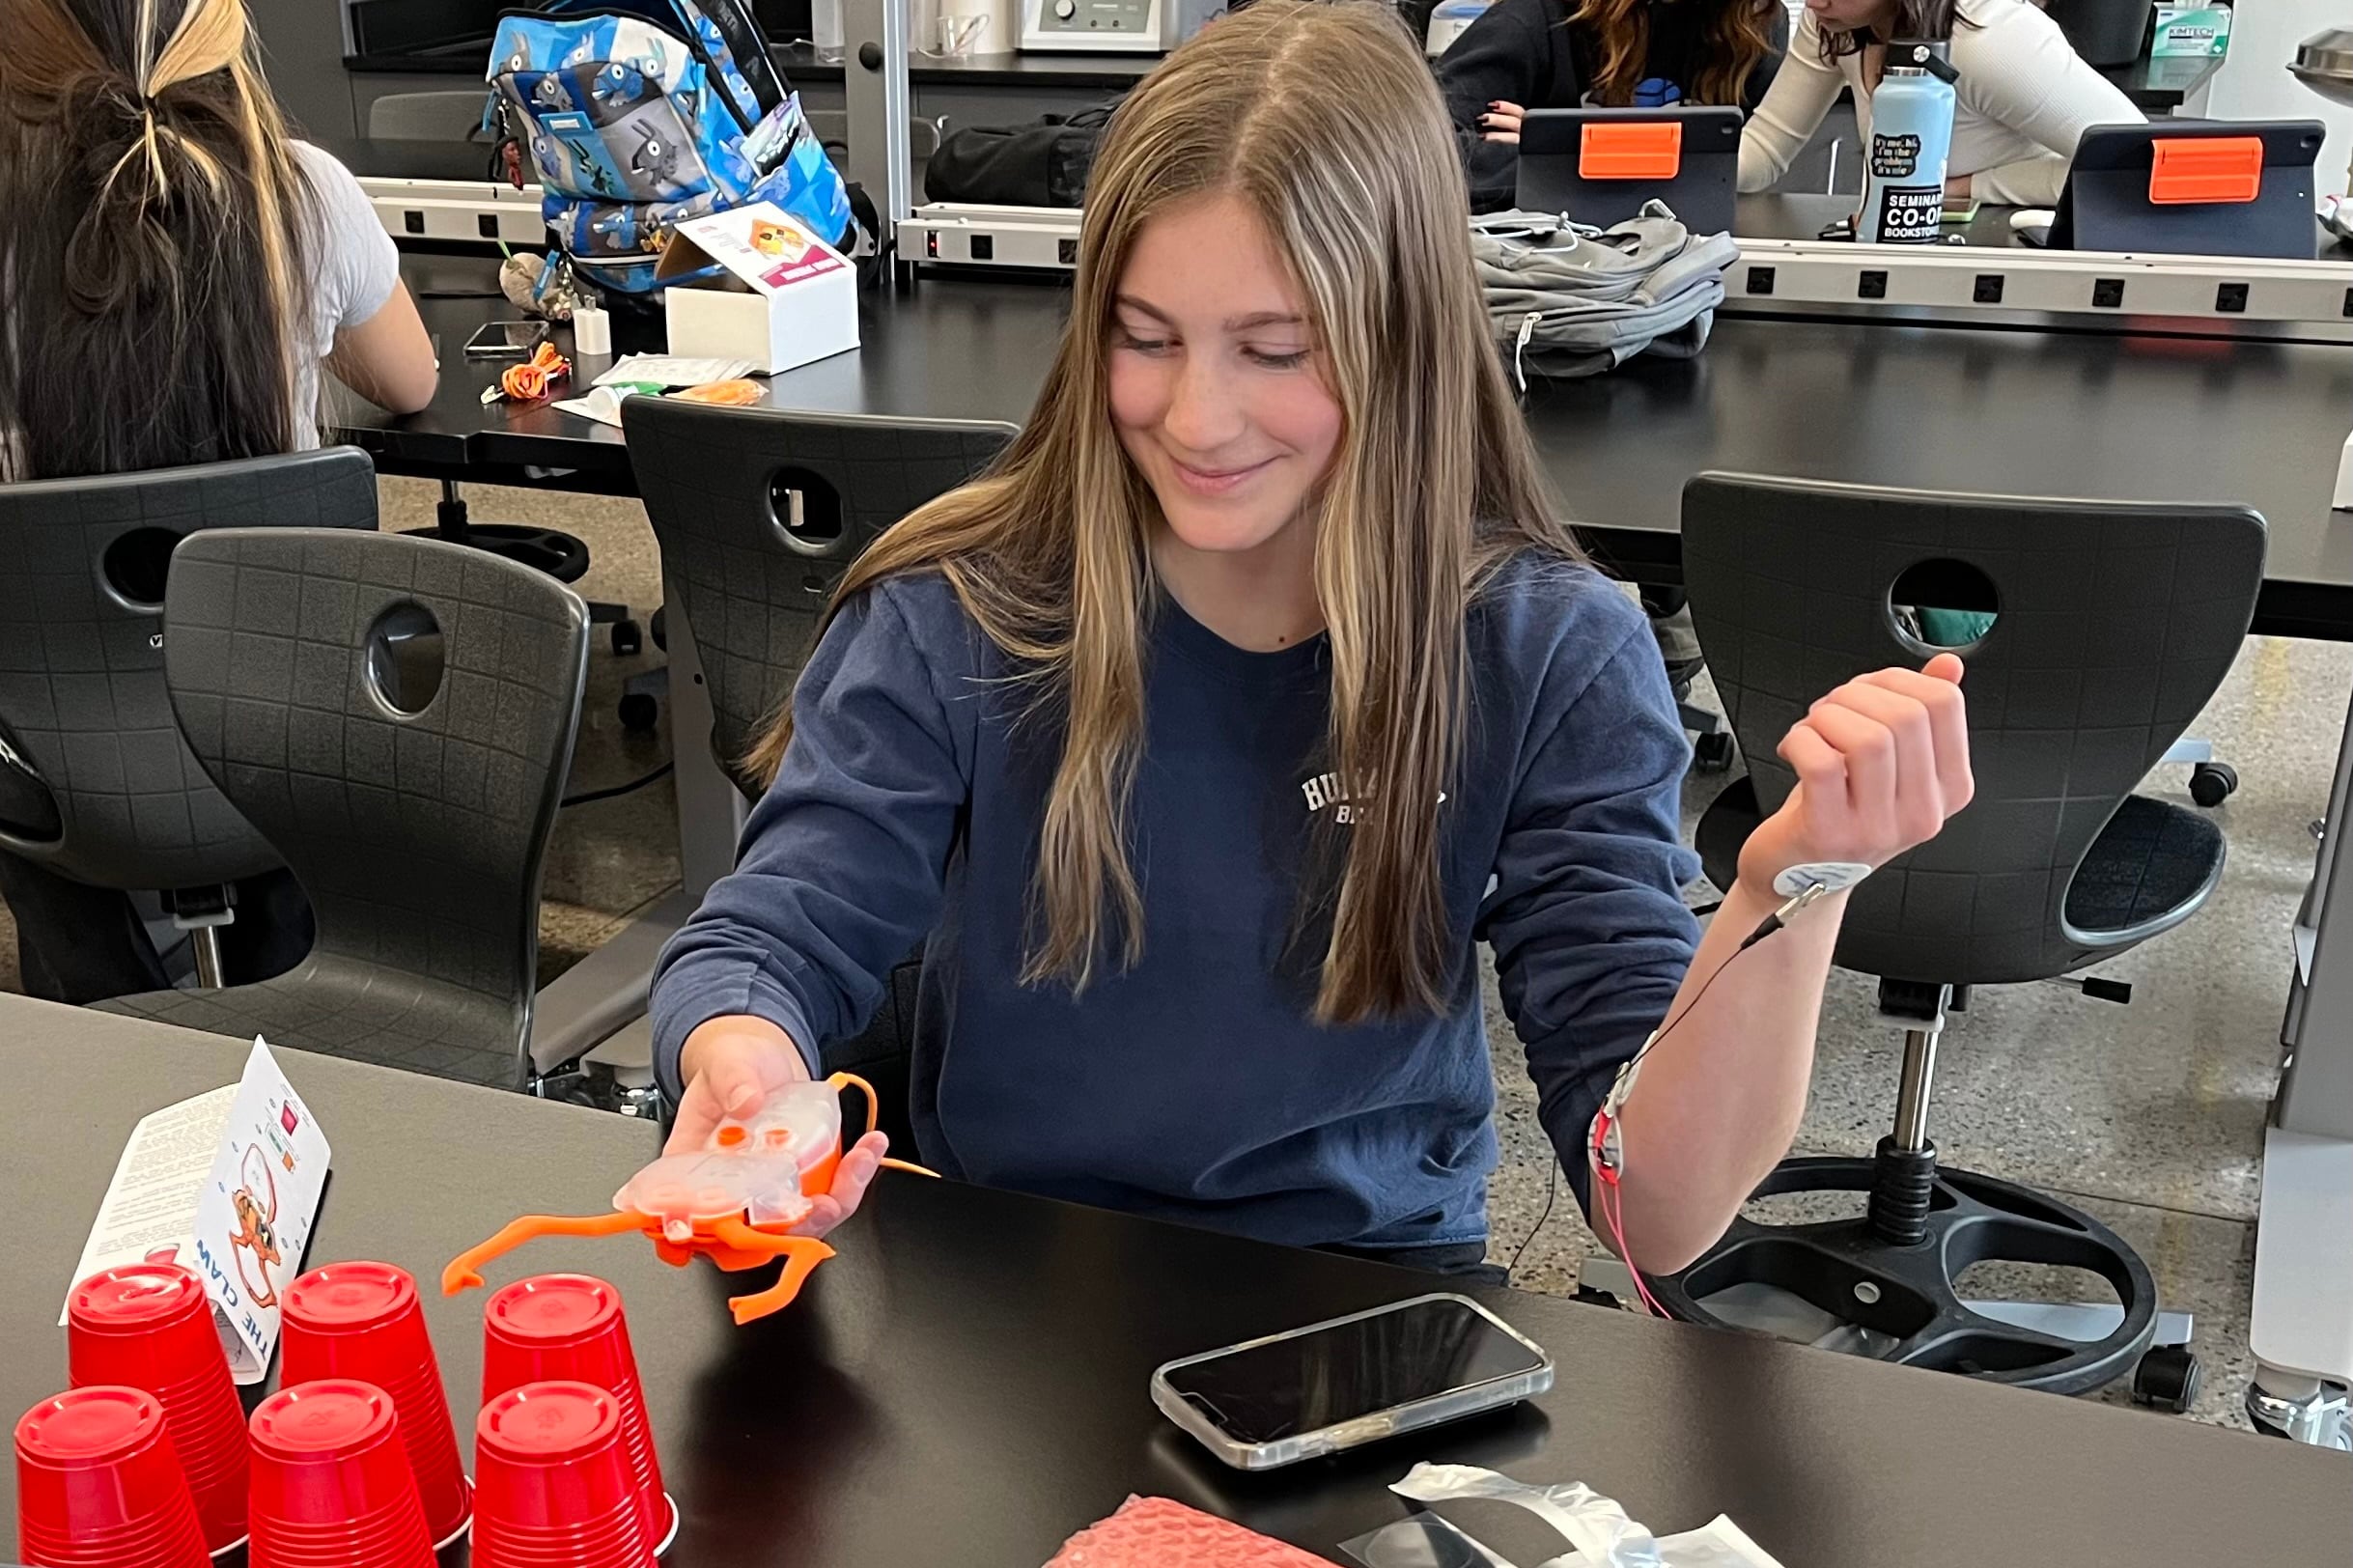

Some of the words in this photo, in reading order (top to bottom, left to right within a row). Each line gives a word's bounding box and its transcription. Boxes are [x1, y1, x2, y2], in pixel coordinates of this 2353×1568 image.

[2170, 27, 2214, 37] KIMTECH
[196, 1239, 238, 1307] CLAW
[241, 1311, 267, 1361] THE
